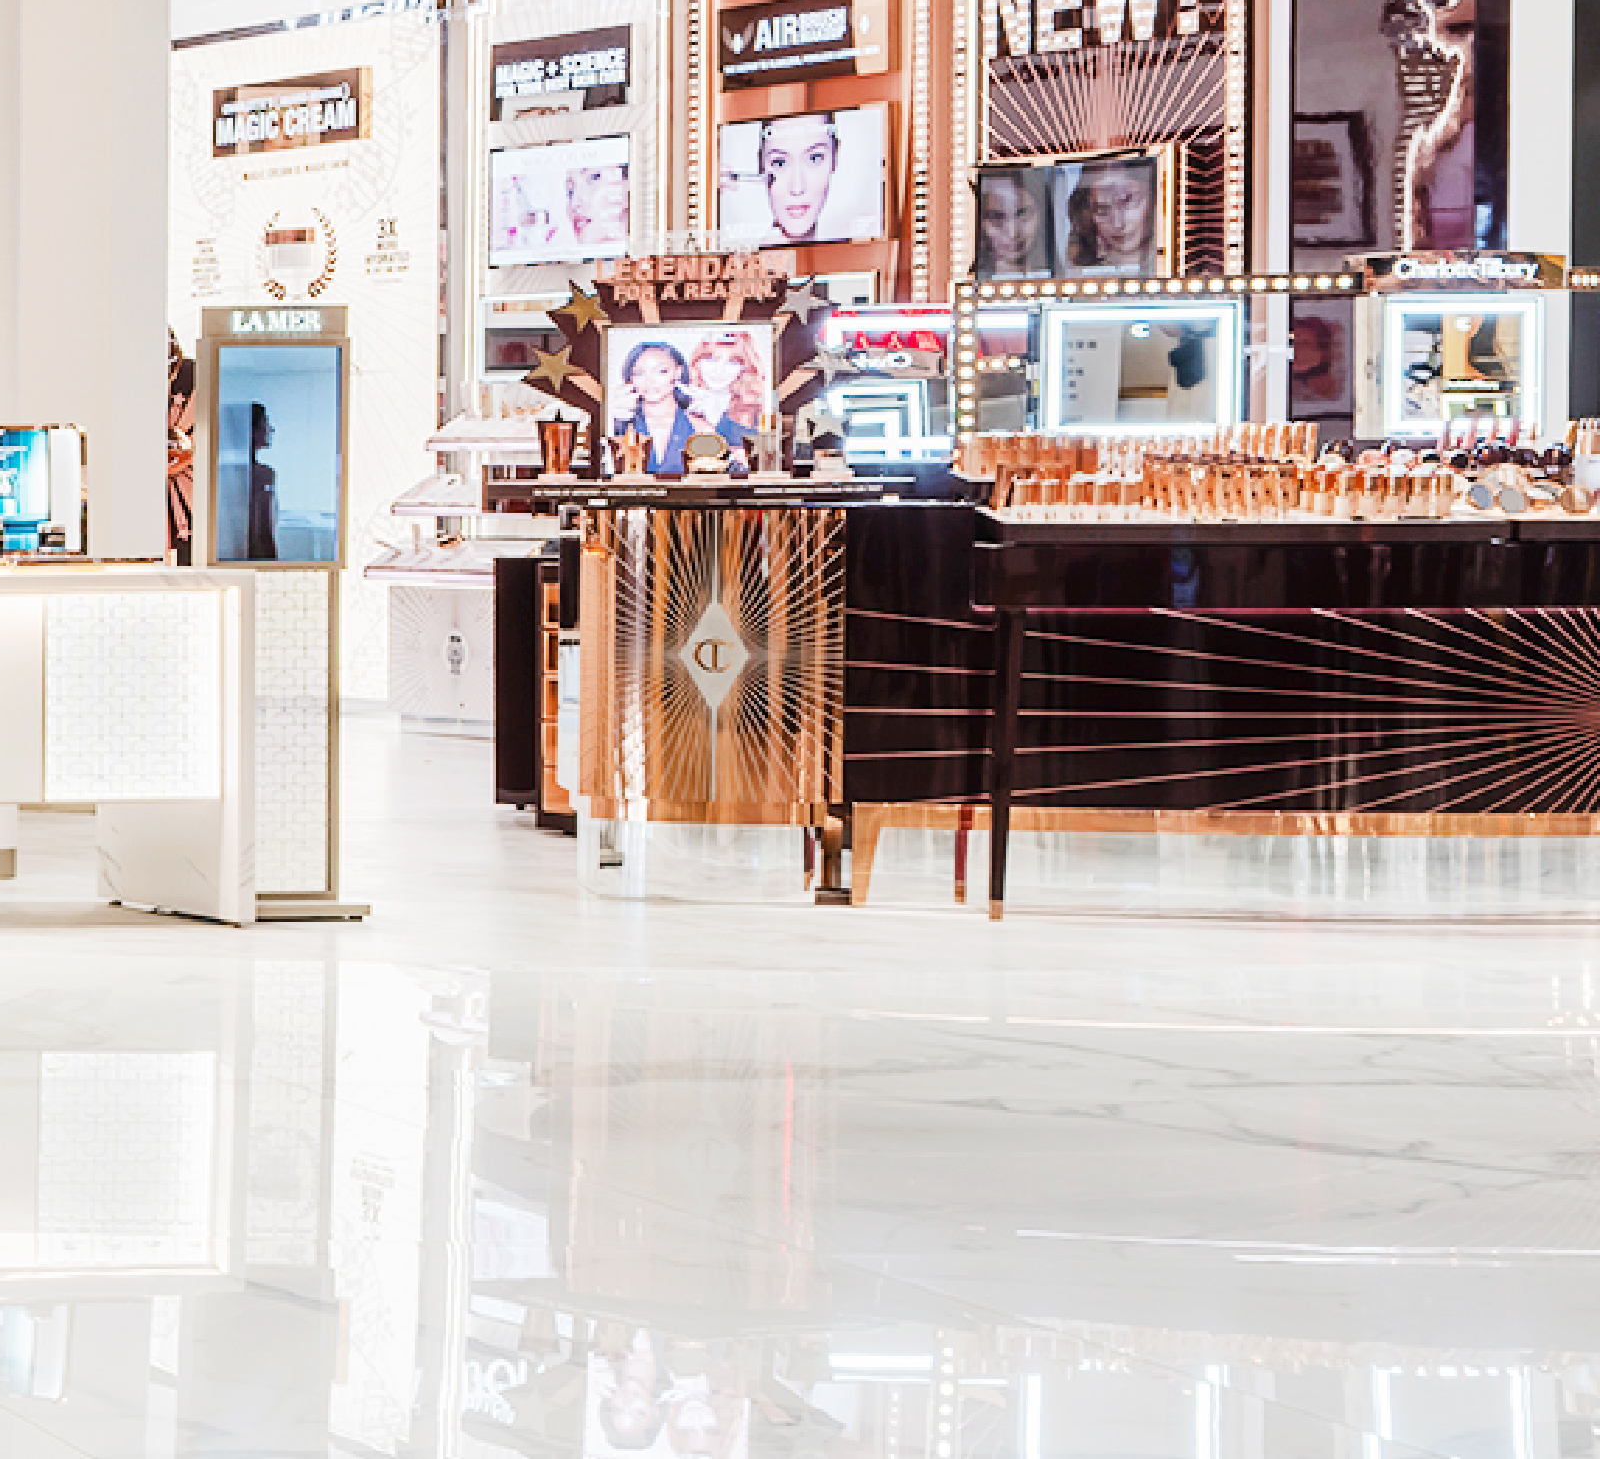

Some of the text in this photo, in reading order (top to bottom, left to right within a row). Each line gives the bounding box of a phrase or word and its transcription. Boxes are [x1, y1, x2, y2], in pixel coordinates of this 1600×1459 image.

[216, 109, 280, 147] MAGIC
[284, 97, 357, 139] CREAM
[231, 309, 322, 332] LA MER
